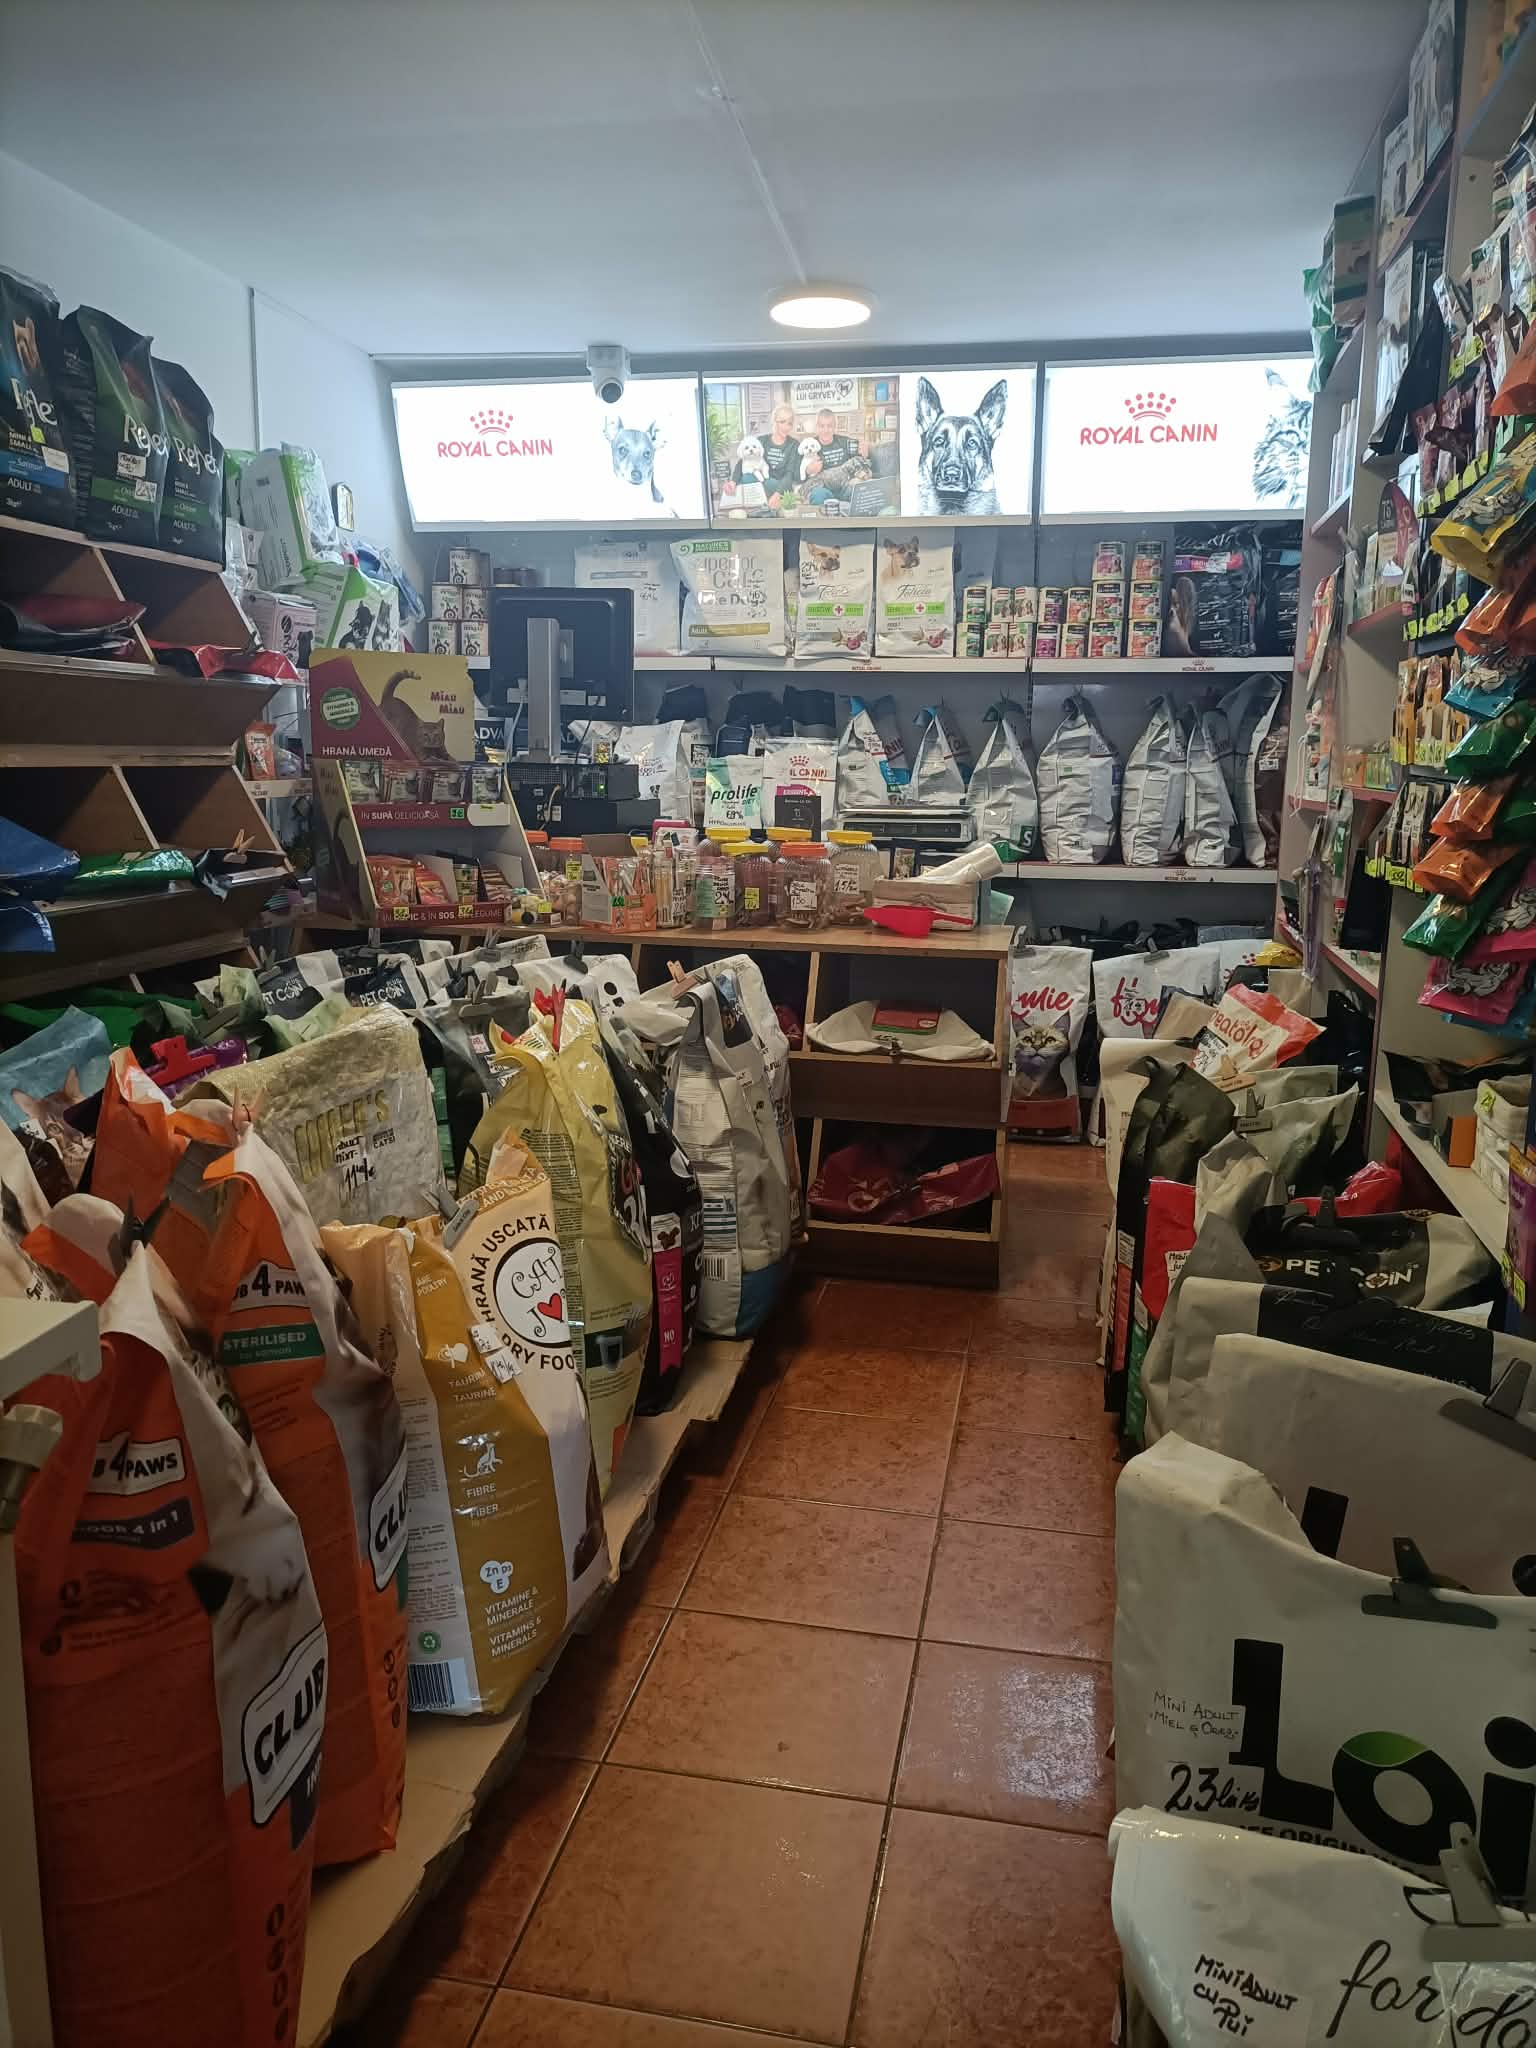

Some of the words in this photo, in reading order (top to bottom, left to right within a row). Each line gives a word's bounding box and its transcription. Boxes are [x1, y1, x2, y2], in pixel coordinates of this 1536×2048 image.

[1080, 425, 1144, 446] ROYAL
[1150, 424, 1218, 444] CANIN
[437, 440, 492, 459] ROYAL
[497, 439, 553, 458] CANIN
[7, 478, 32, 491] ADULT
[711, 783, 758, 804] prolife
[438, 911, 455, 920] SOS
[482, 1213, 551, 1253] USCATĂ
[1285, 1257, 1321, 1278] PE
[252, 1263, 271, 1297] 4
[275, 1279, 306, 1296] PAW
[471, 1256, 496, 1323] HRANĂ
[223, 1331, 306, 1352] STERILISED
[501, 1332, 536, 1366] DRY
[540, 1352, 576, 1371] FOO
[454, 1388, 496, 1402] TAURINE
[110, 1436, 130, 1482] 4
[126, 1452, 178, 1477] PAWS
[466, 1482, 497, 1498] FIBRE
[375, 1484, 408, 1553] CLU
[469, 1503, 499, 1518] FIBER
[484, 1566, 499, 1577] Zn
[496, 1578, 504, 1590] E
[485, 1592, 530, 1616] VITAMINE
[487, 1599, 535, 1626] MINERALE
[490, 1621, 535, 1646] VITAMINS
[491, 1631, 538, 1658] MINERALS
[254, 1656, 326, 1775] CLUB
[1326, 1939, 1446, 2039] for
